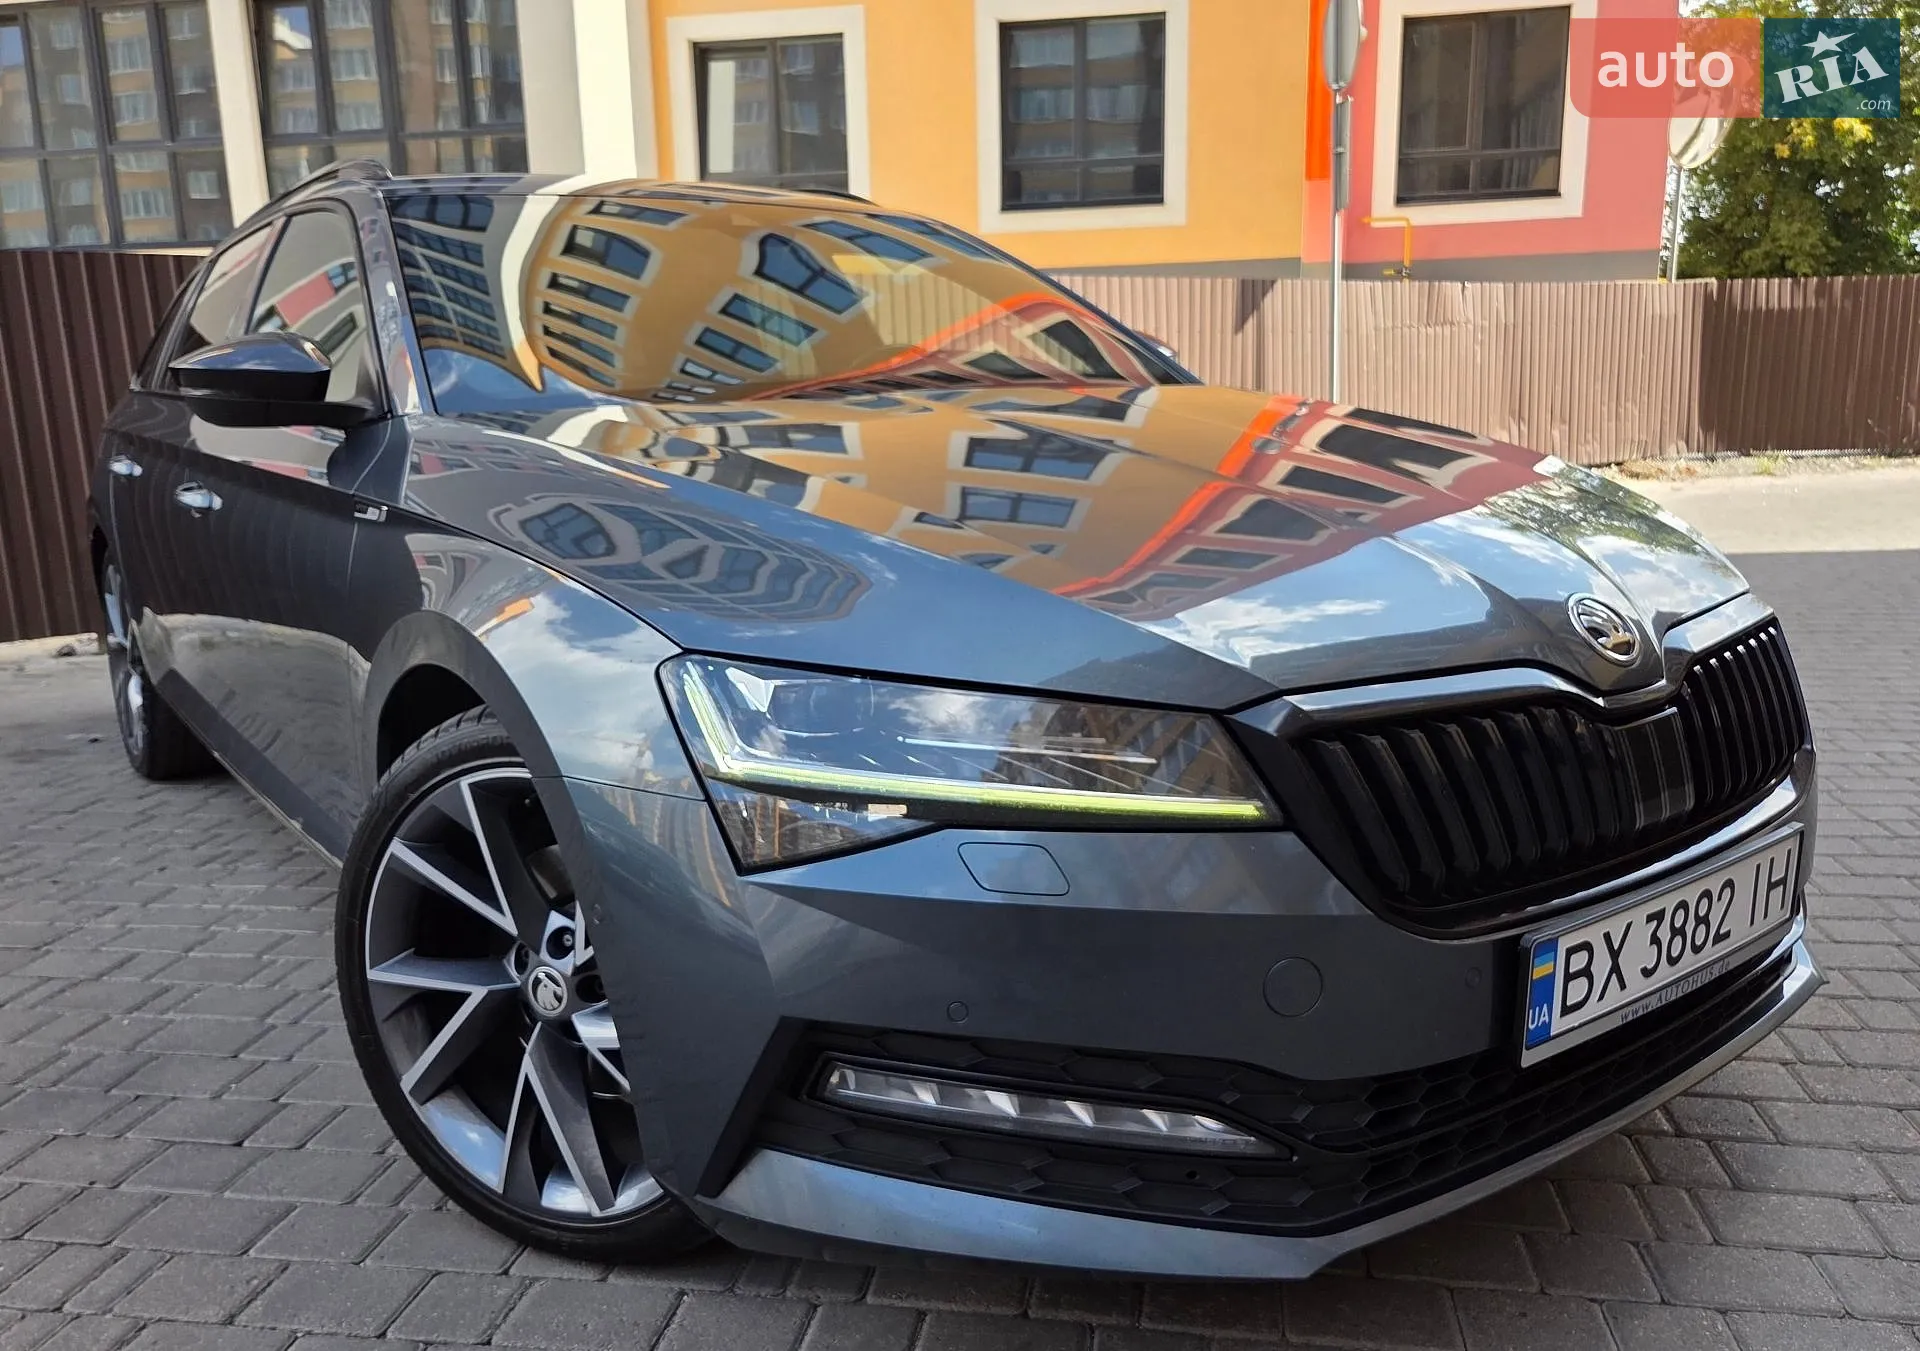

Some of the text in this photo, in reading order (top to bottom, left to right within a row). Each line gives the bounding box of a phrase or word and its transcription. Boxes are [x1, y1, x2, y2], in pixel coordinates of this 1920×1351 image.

[1560, 848, 1792, 1018] BX 3882 IH
[1528, 1007, 1549, 1029] UA
